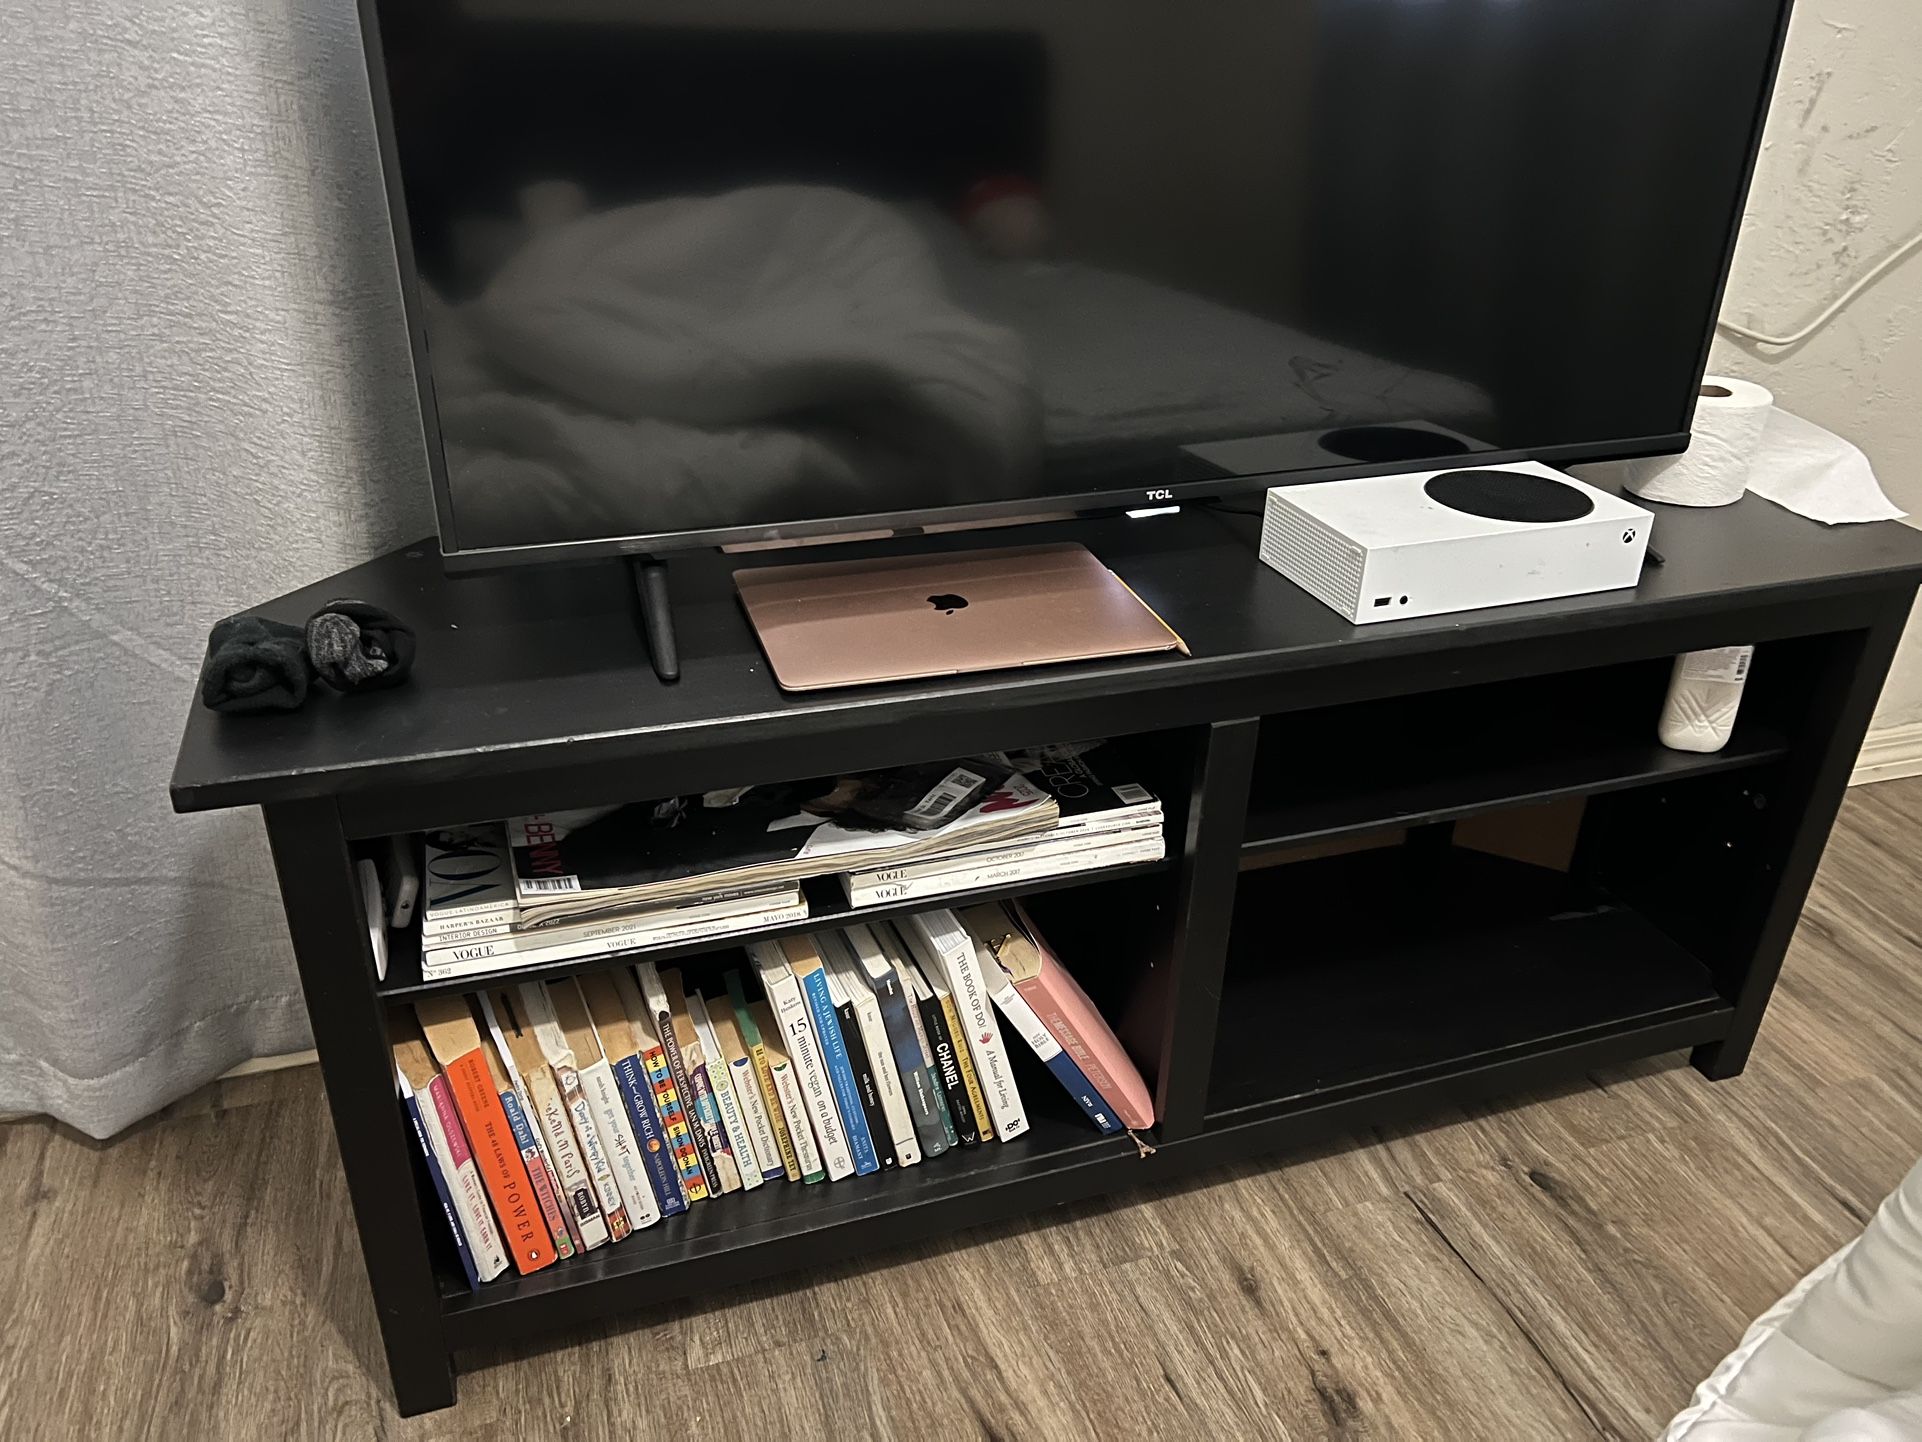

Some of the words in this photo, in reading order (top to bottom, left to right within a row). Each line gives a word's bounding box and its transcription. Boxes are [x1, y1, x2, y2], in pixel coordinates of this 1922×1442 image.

[1146, 489, 1173, 500] TCL
[986, 853, 1012, 863] OCTOBER
[876, 870, 907, 882] VOGUE
[987, 870, 1009, 879] MARCH
[875, 886, 907, 899] VOGUE
[439, 920, 474, 930] HARPER'S
[475, 916, 504, 925] BAZAAR
[763, 912, 784, 923] MAYO
[439, 932, 471, 942] INTERIOR
[473, 928, 497, 937] DESIGN
[583, 926, 620, 938] SEPTEMBER
[453, 945, 495, 960] VOGUE
[607, 938, 636, 949] VOGUE
[954, 951, 970, 975] THE
[961, 973, 978, 1000] BOOK
[969, 998, 981, 1012] OF
[812, 972, 827, 1003] LIVING
[821, 1010, 837, 1041] JEWISH
[830, 1037, 843, 1060] LIFE
[660, 1022, 673, 1038] THE
[789, 1017, 807, 1036] 15
[648, 1050, 659, 1068] HOW
[664, 1036, 680, 1063] POWER
[795, 1034, 815, 1070] minute
[876, 1050, 884, 1059] the
[984, 1048, 995, 1057] A
[672, 1060, 682, 1072] OF
[880, 1065, 888, 1074] and
[935, 1041, 960, 1090] CHANEL
[960, 1055, 970, 1068] THE
[987, 1055, 1002, 1080] Manual
[653, 1068, 663, 1079] TO
[861, 1072, 870, 1084] milk
[882, 1072, 890, 1082] her
[911, 1070, 922, 1089] William
[964, 1068, 976, 1085] FOUR
[466, 1058, 481, 1084] ROBERT
[475, 1083, 490, 1109] GREENE
[657, 1078, 666, 1089] BE
[674, 1068, 694, 1109] PERSPECTIVE
[740, 1068, 757, 1100] Webster's
[778, 1072, 795, 1105] Webster's
[803, 1068, 823, 1099] vegan
[864, 1083, 872, 1093] and
[884, 1080, 894, 1097] flowers
[992, 1078, 1005, 1090] for
[431, 1083, 450, 1121] MARIANNA
[620, 1058, 637, 1087] THINK
[631, 1093, 647, 1119] GROW
[640, 1118, 654, 1140] RICH
[660, 1088, 677, 1123] YOURSELF
[719, 1089, 738, 1125] BEAUTY
[749, 1099, 760, 1114] New
[815, 1099, 826, 1112] on
[865, 1091, 876, 1108] honey
[916, 1087, 930, 1116] Shakespeare
[969, 1084, 985, 1121] AGREEMENTS
[996, 1087, 1011, 1110] Living
[503, 1095, 520, 1122] Roald
[514, 1122, 529, 1145] Dahl
[603, 1108, 614, 1120] get
[787, 1103, 800, 1119] New
[483, 1121, 496, 1139] THE
[607, 1119, 619, 1134] your
[687, 1108, 697, 1121] IAN
[693, 1128, 706, 1148] DAVIS
[731, 1124, 741, 1133] &
[754, 1114, 767, 1136] Pocket
[792, 1119, 806, 1141] Pocket
[819, 1116, 839, 1146] budget
[489, 1138, 498, 1148] 48
[572, 1100, 591, 1126] Diary
[593, 1158, 607, 1174] Kid
[859, 1135, 869, 1153] ANITA
[492, 1146, 506, 1167] LAWS
[672, 1125, 684, 1147] SIMON
[679, 1146, 694, 1175] DOONAN
[733, 1132, 752, 1168] HEALTH
[759, 1135, 775, 1167] Dictionary
[777, 1126, 793, 1159] JOSEPHINE
[787, 1159, 796, 1172] TEY
[798, 1139, 815, 1171] Thesaurus
[851, 1134, 864, 1160] DIAMANT
[500, 1168, 511, 1180] OF
[531, 1166, 545, 1185] THE
[619, 1155, 636, 1183] together
[652, 1152, 667, 1184] NAPOLEON
[661, 1182, 670, 1196] HILL
[700, 1147, 714, 1176] EVERGREEN
[708, 1173, 719, 1188] PRESS
[537, 1183, 559, 1222] WITCHES
[600, 1181, 616, 1207] KINNEY
[501, 1180, 536, 1243] POWER
